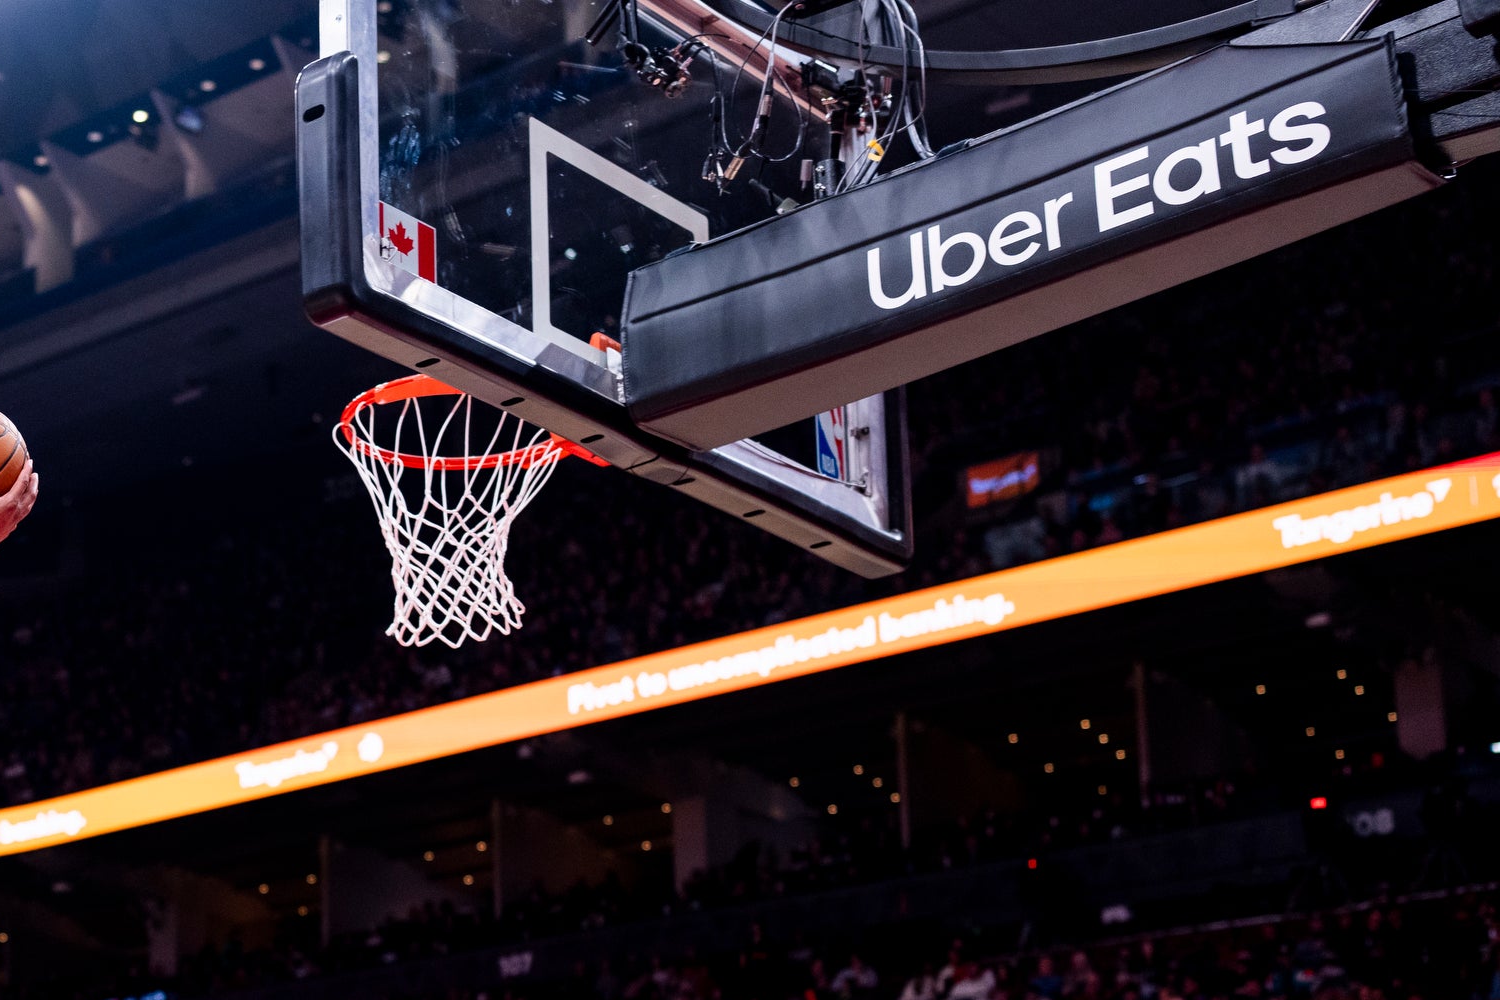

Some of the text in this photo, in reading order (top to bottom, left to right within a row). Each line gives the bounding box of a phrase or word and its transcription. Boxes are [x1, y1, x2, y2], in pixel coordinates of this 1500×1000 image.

[867, 101, 1332, 310] Uber Eats
[1272, 492, 1434, 549] Tangerine
